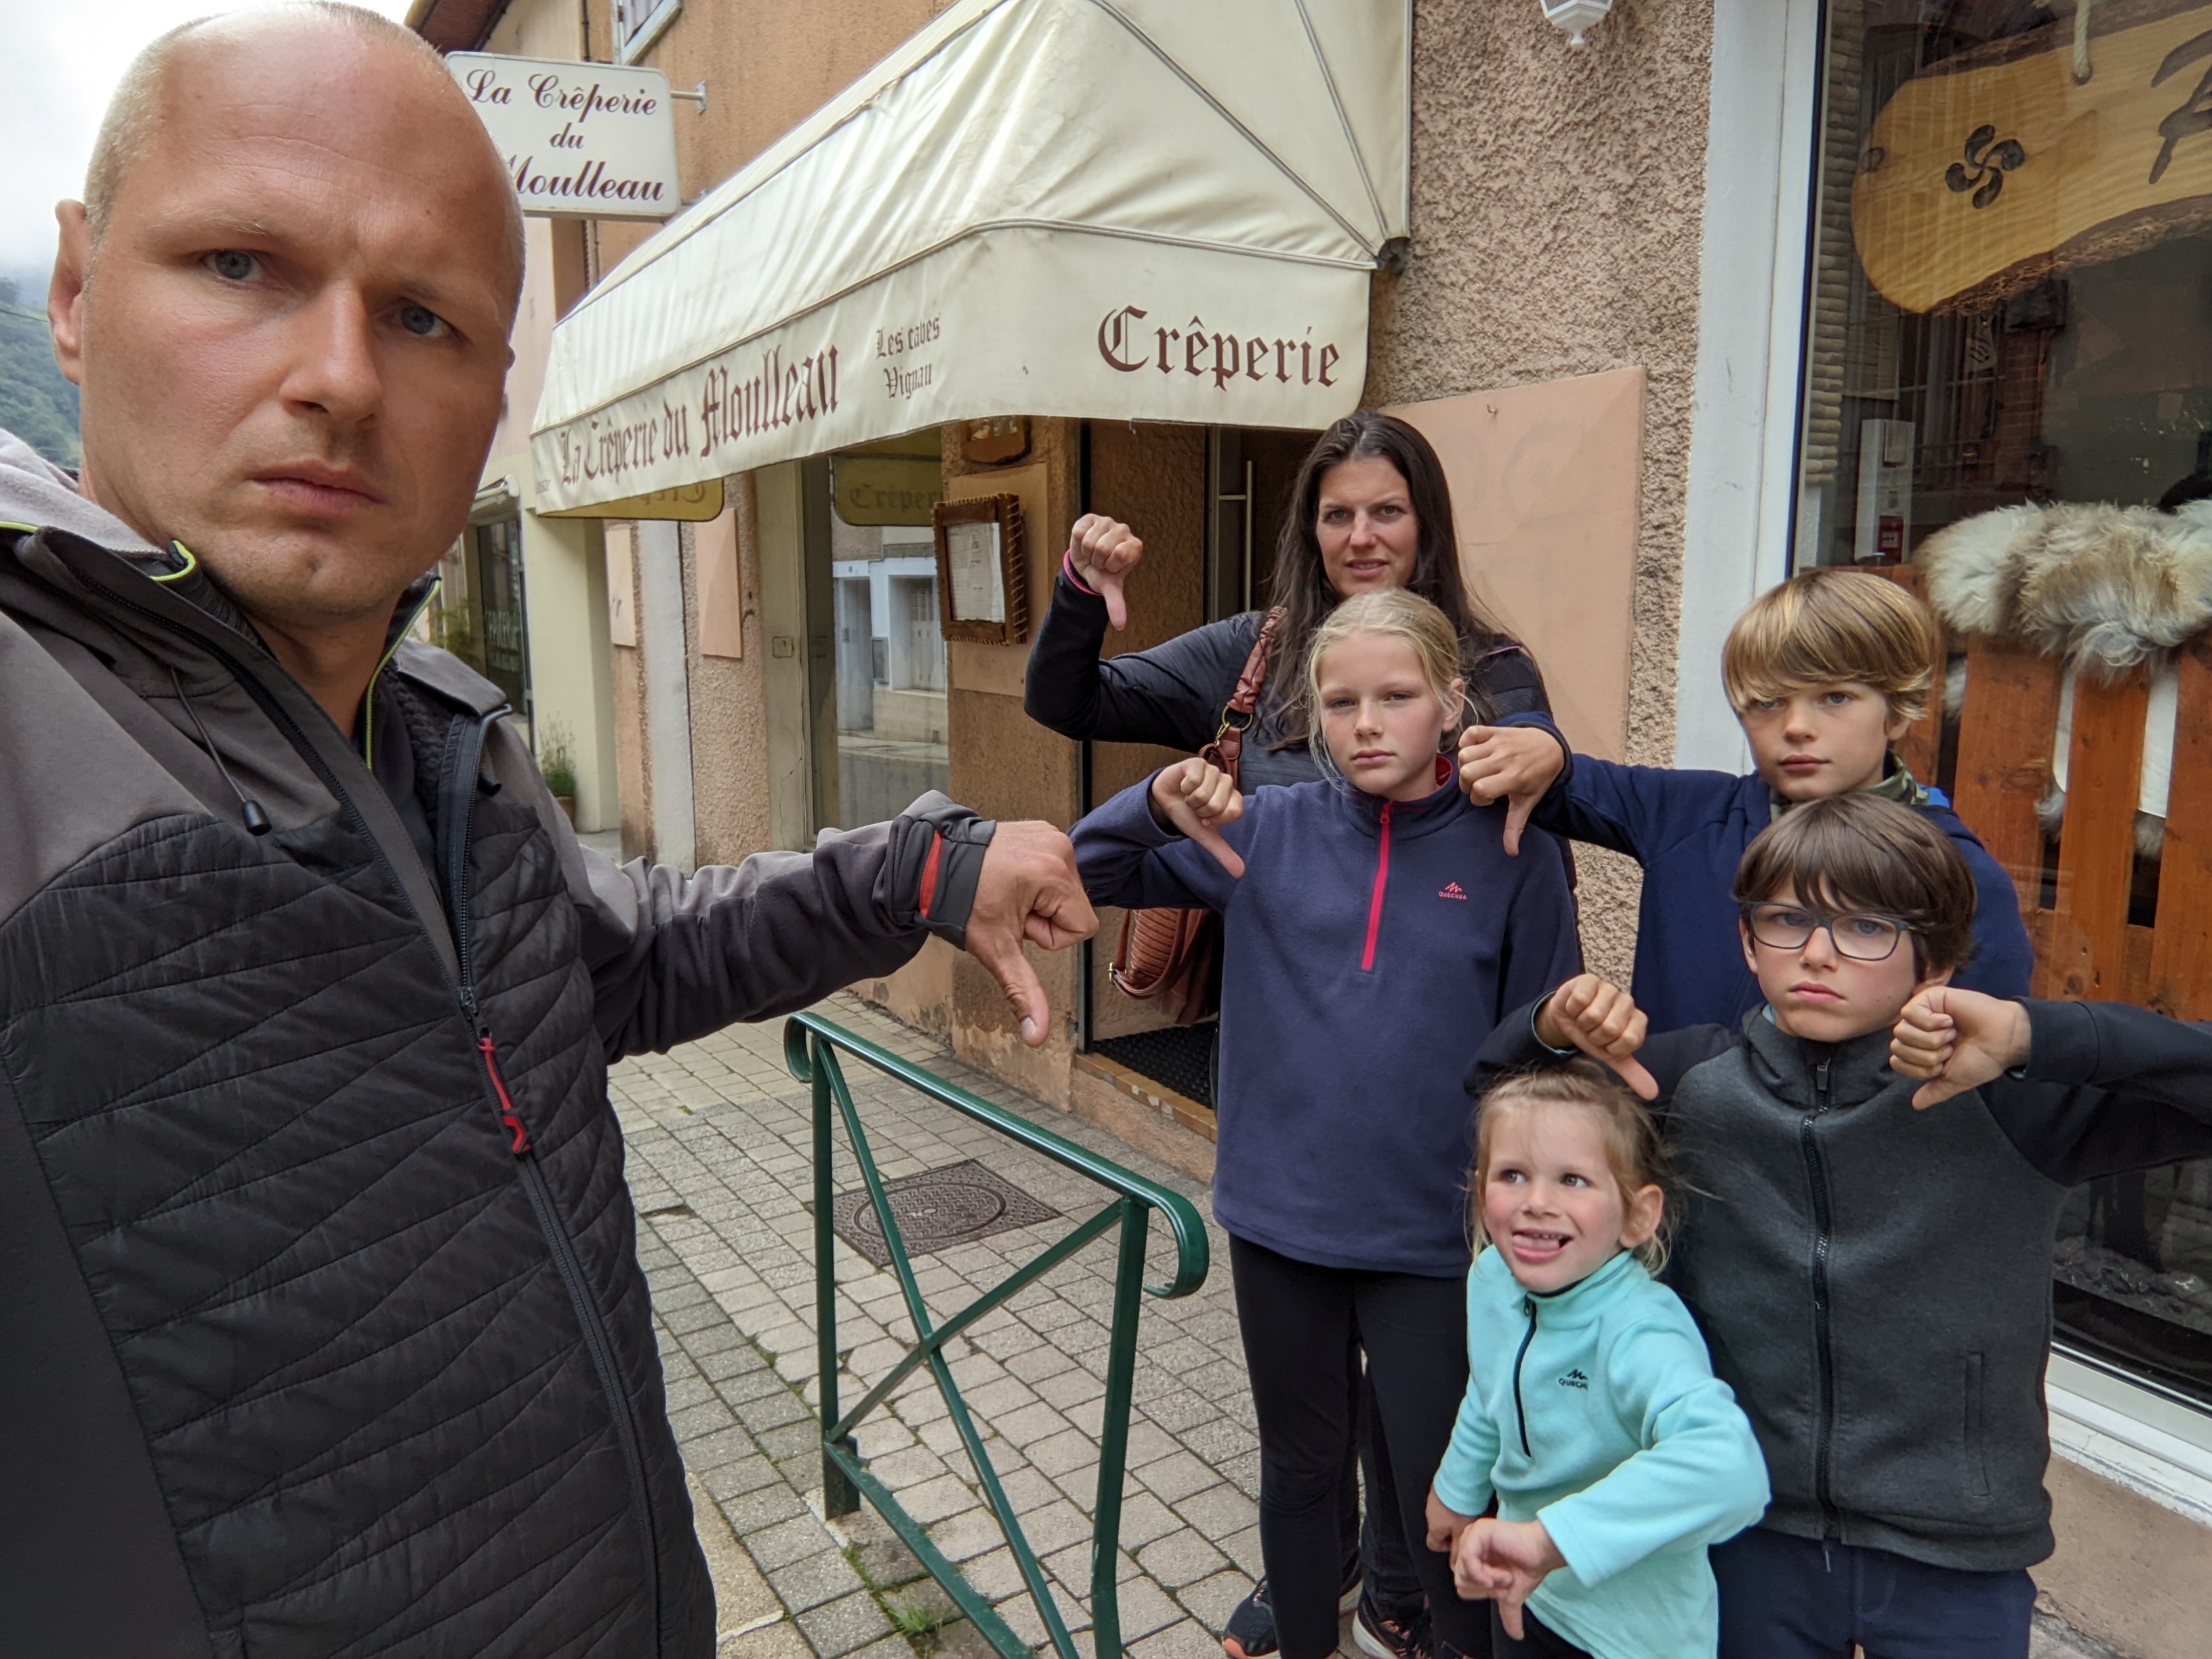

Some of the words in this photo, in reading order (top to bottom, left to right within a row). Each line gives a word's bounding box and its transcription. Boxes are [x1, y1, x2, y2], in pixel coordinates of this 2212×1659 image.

[466, 69, 512, 104] La
[528, 73, 657, 123] Crêperie
[549, 122, 583, 149] du
[876, 327, 903, 360] Les
[1097, 304, 1340, 392] Crêperie
[561, 428, 581, 487] La
[583, 403, 658, 486] Crêperie
[663, 396, 689, 460] du
[700, 344, 838, 462] Moulleau
[1438, 891, 1467, 900] QUECHUA
